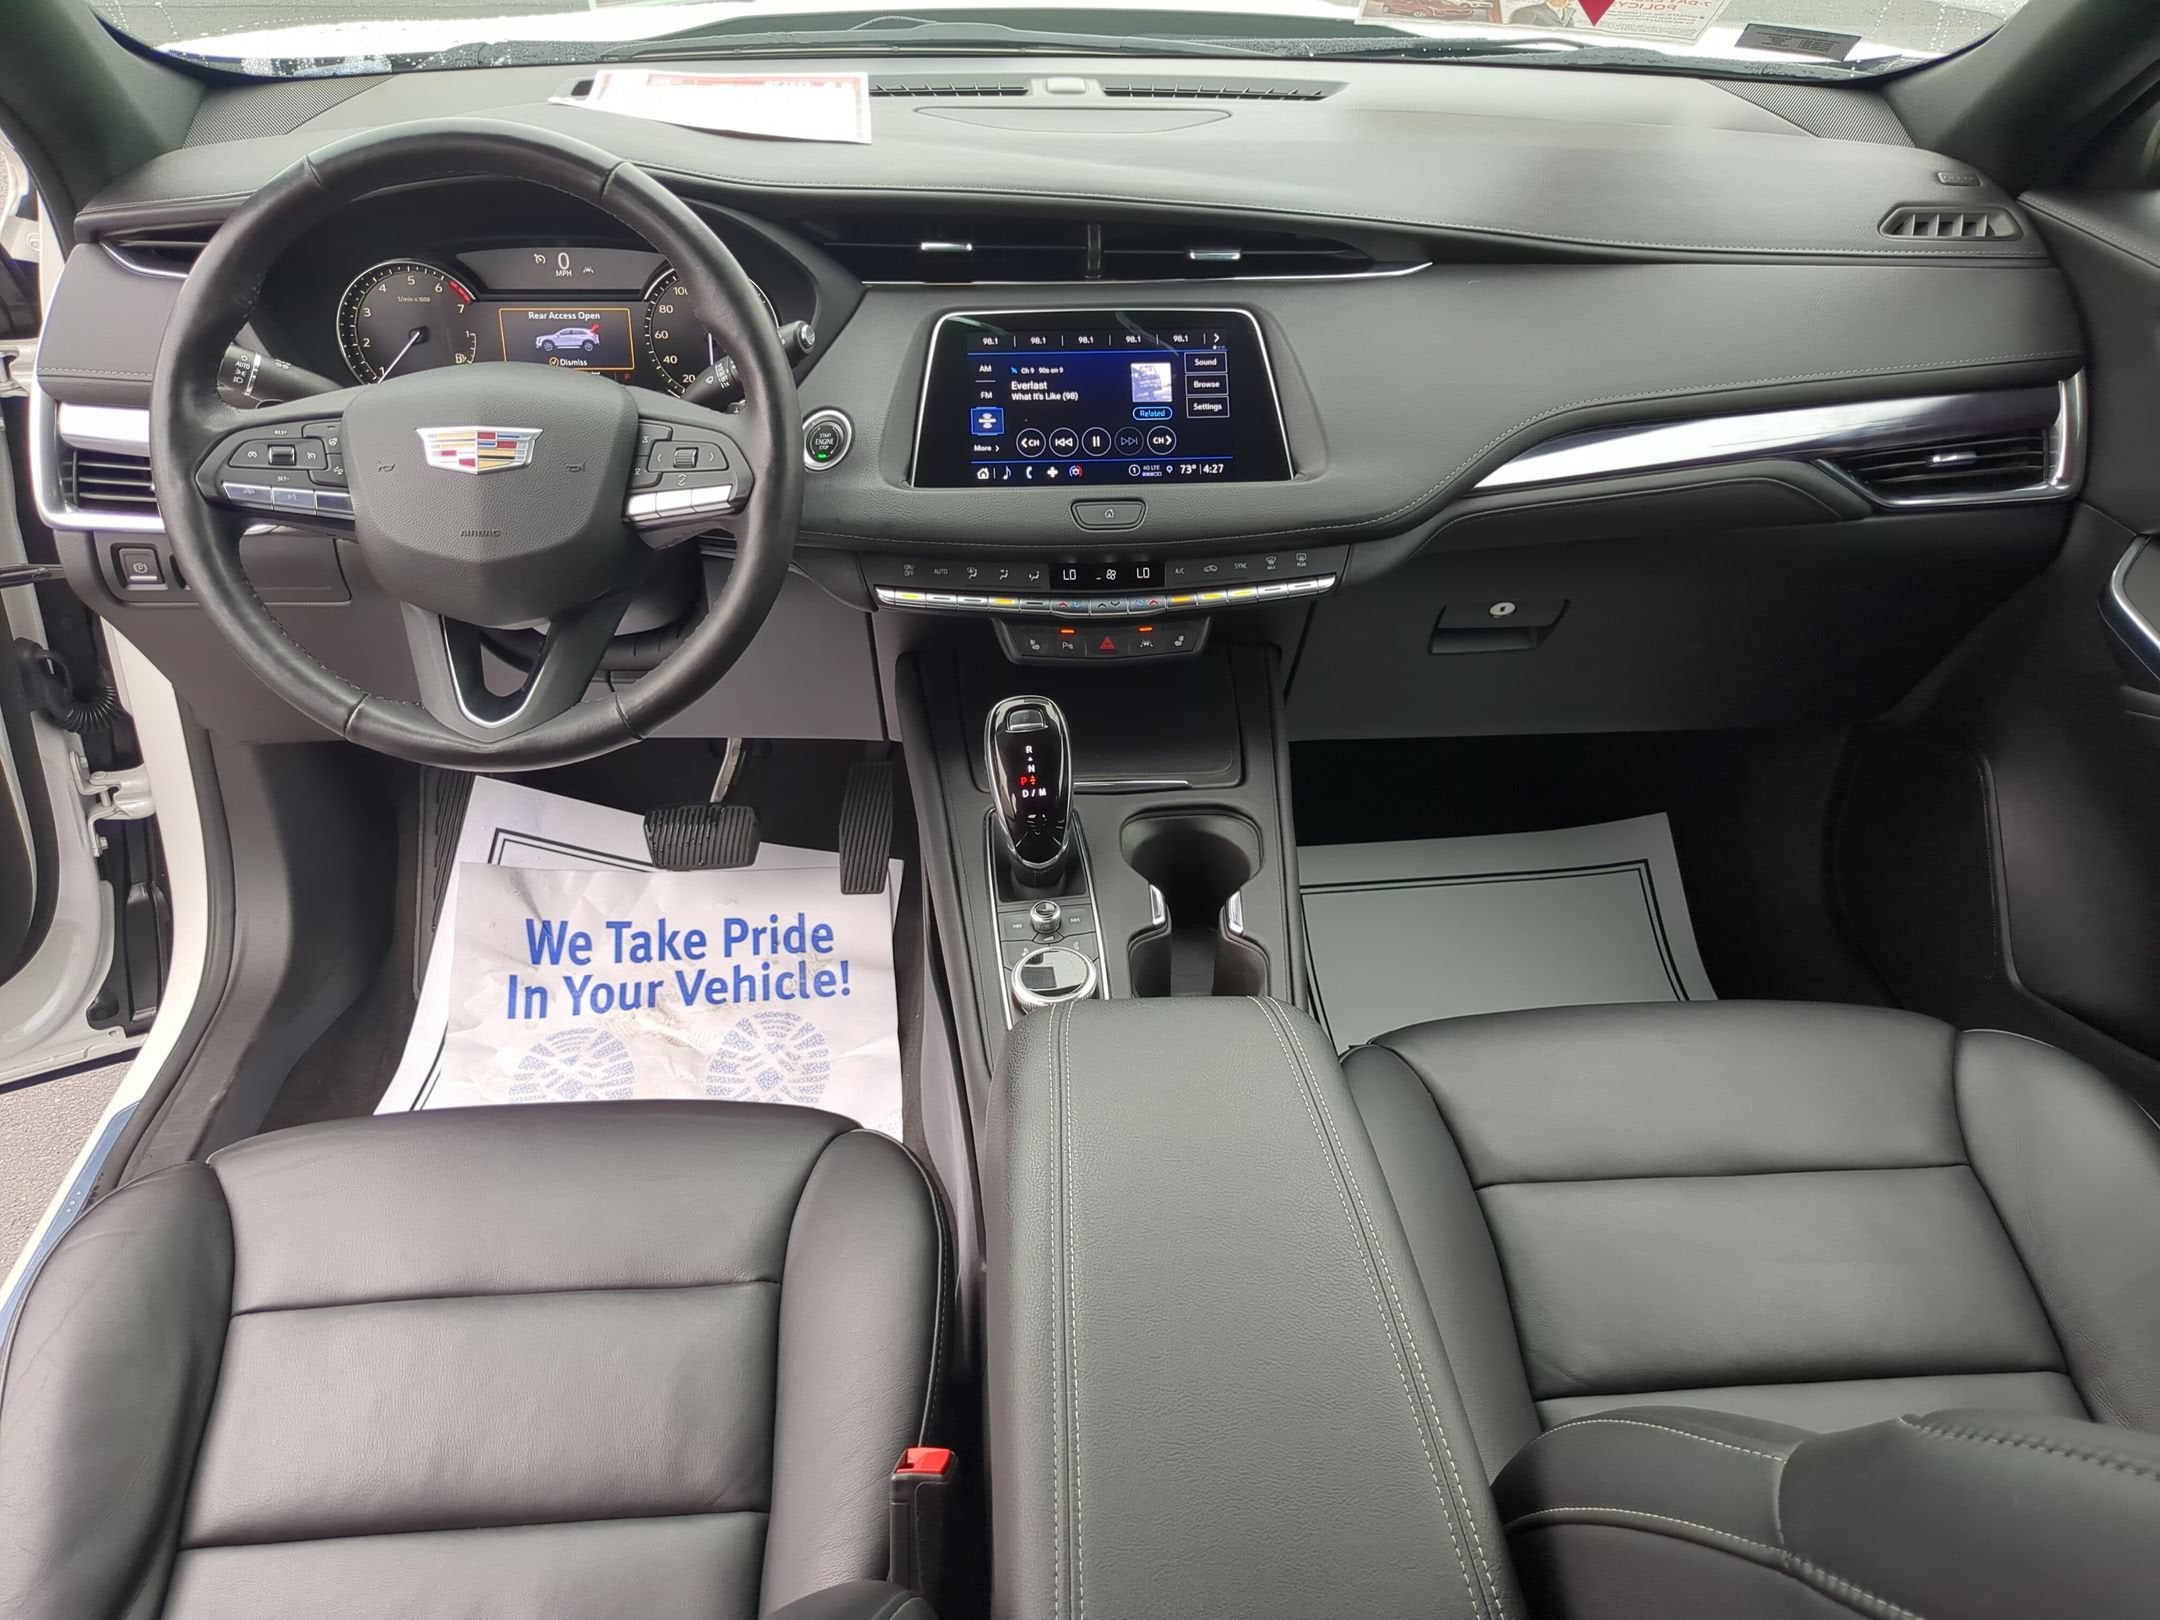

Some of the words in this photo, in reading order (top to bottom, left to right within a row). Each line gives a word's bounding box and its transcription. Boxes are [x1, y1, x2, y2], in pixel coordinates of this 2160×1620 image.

[557, 252, 570, 270] 0
[555, 269, 573, 277] MPH
[407, 275, 416, 285] 5
[378, 283, 387, 293] 4
[434, 282, 443, 293] 6
[363, 307, 372, 318] 3
[457, 304, 465, 314] 7
[658, 304, 674, 314] 80
[528, 311, 548, 320] Rear
[549, 311, 577, 320] Access
[578, 311, 601, 321] Open
[654, 330, 669, 340] 60
[982, 337, 999, 345] 98.1
[1030, 336, 1046, 345] 98.1
[1078, 335, 1094, 344] 98.1
[1125, 335, 1141, 344] 98.1
[1173, 334, 1189, 343] 98.1
[363, 338, 371, 348] 2
[560, 358, 588, 367] Dismiss
[662, 355, 678, 364] 40
[1194, 358, 1217, 367] Sound
[235, 360, 251, 370] AUTO
[979, 364, 993, 373] AM
[682, 374, 696, 383] 20
[1011, 381, 1048, 391] Everlast
[1193, 380, 1220, 389] Browse
[980, 391, 993, 399] FM
[1011, 392, 1032, 401] What
[1033, 392, 1044, 401] It's
[1045, 392, 1061, 401] Like
[1062, 391, 1079, 402] (98)
[1193, 402, 1223, 413] Settings
[1140, 409, 1166, 417] Related
[815, 438, 834, 446] ENGINE
[1028, 439, 1040, 447] CH
[1153, 436, 1165, 445] CH
[974, 444, 992, 452] More
[1203, 464, 1224, 474] 4:27
[1174, 567, 1185, 575] A/C
[1234, 562, 1248, 570] SYNC
[1062, 569, 1077, 581] LO
[1136, 567, 1151, 579] LO
[1025, 745, 1033, 754] R
[1027, 764, 1036, 773] N
[1020, 776, 1028, 786] P
[525, 917, 593, 966] We
[605, 917, 707, 964] Take
[723, 912, 834, 958] Pride
[507, 974, 548, 1019] In
[562, 974, 665, 1016] Your
[674, 960, 851, 1006] Vehicle!
